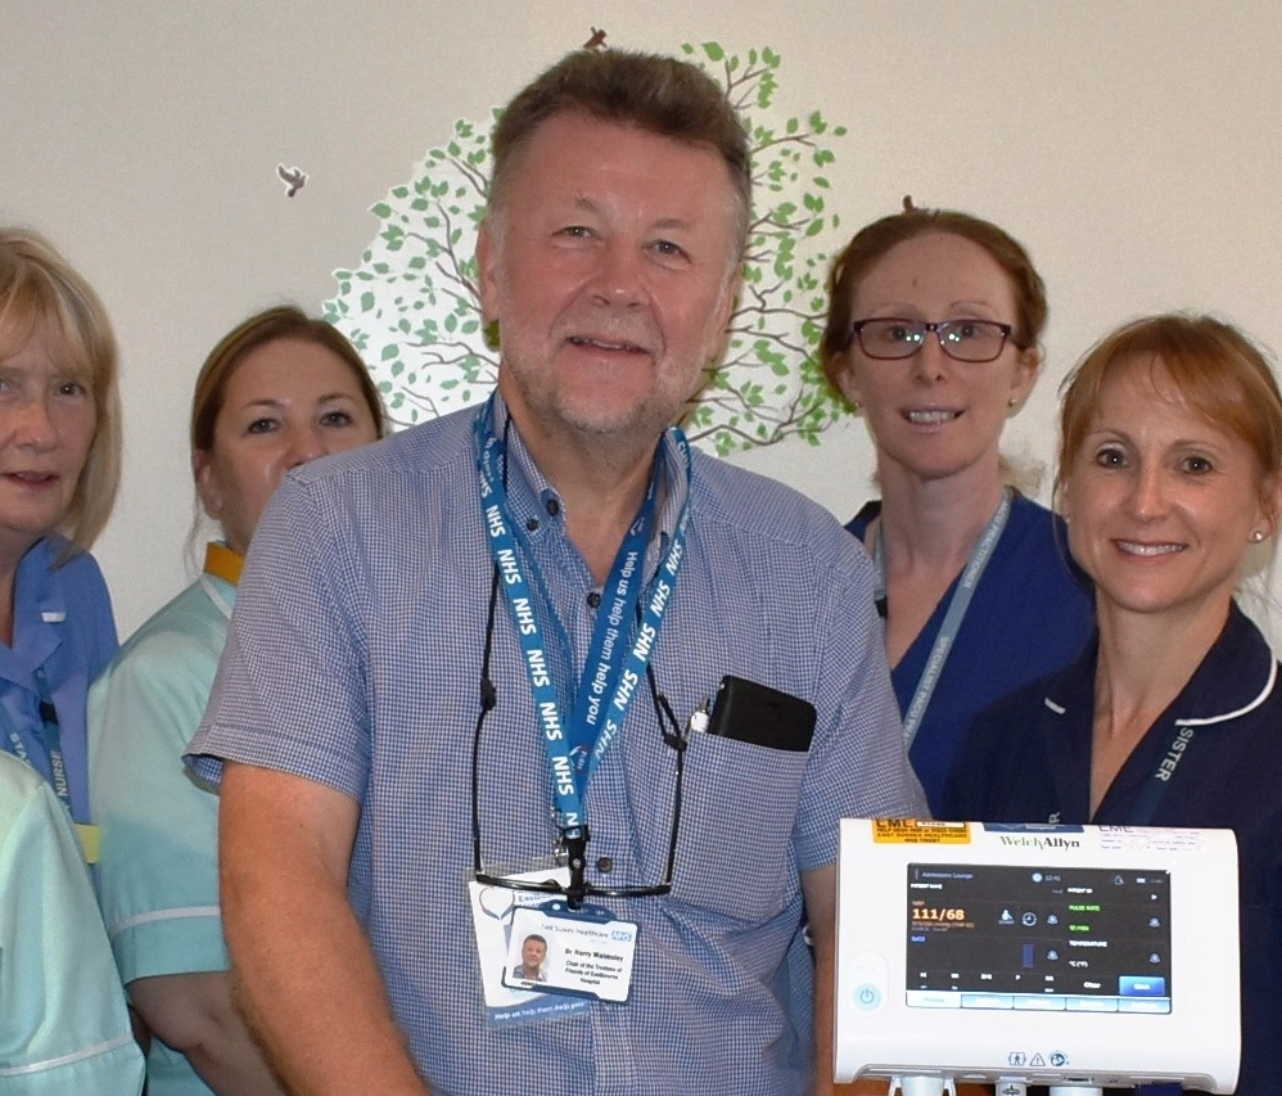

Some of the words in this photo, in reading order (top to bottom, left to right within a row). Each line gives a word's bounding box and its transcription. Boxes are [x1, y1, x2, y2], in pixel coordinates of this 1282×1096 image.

[486, 504, 505, 538] NHS
[497, 548, 522, 585] NHS
[626, 551, 638, 578] Help
[665, 539, 684, 575] NHS
[617, 579, 628, 596] us
[650, 580, 671, 618] NHS
[513, 597, 537, 636] NHS
[609, 598, 624, 627] help
[600, 628, 617, 661] them
[633, 622, 656, 662] NHS
[527, 649, 550, 687] NHS
[592, 662, 610, 696] help
[613, 669, 638, 711] NHS
[539, 701, 563, 742] NHS
[585, 698, 599, 727] you
[50, 750, 68, 796] NURSE
[1155, 727, 1194, 783] SISTER
[552, 756, 574, 795] NHS
[1000, 836, 1080, 850] WelchAllyn
[912, 908, 965, 920] 111/68
